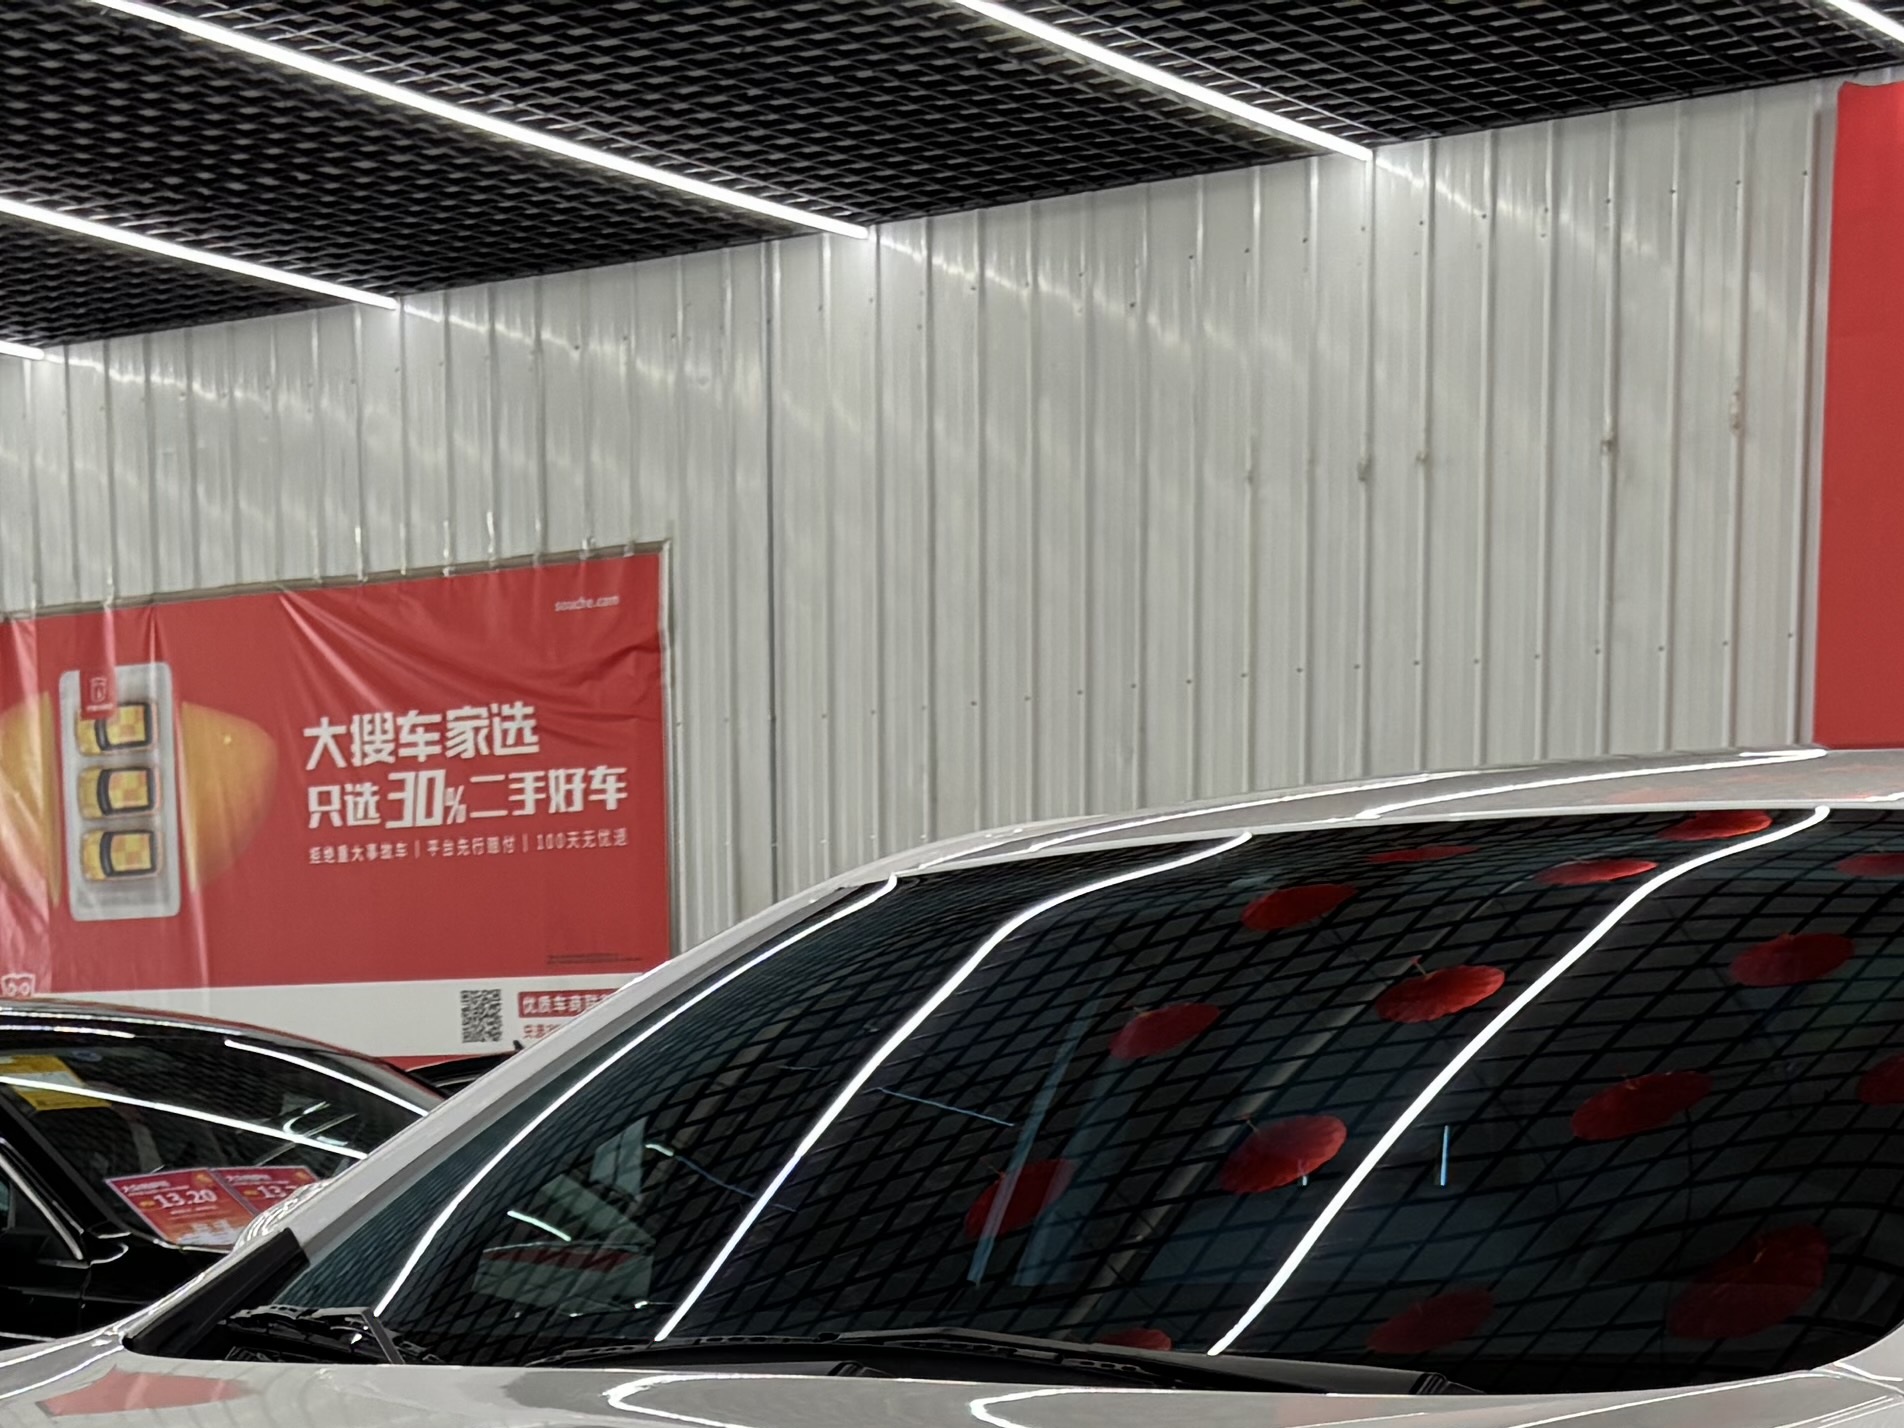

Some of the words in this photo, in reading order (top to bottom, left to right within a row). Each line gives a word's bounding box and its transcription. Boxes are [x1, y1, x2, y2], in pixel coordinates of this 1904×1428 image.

[303, 701, 540, 770] 大搜车家选
[307, 765, 628, 829] 只选30%二手好车
[522, 993, 611, 1014] 优质车商联
[153, 1188, 218, 1209] 13.20
